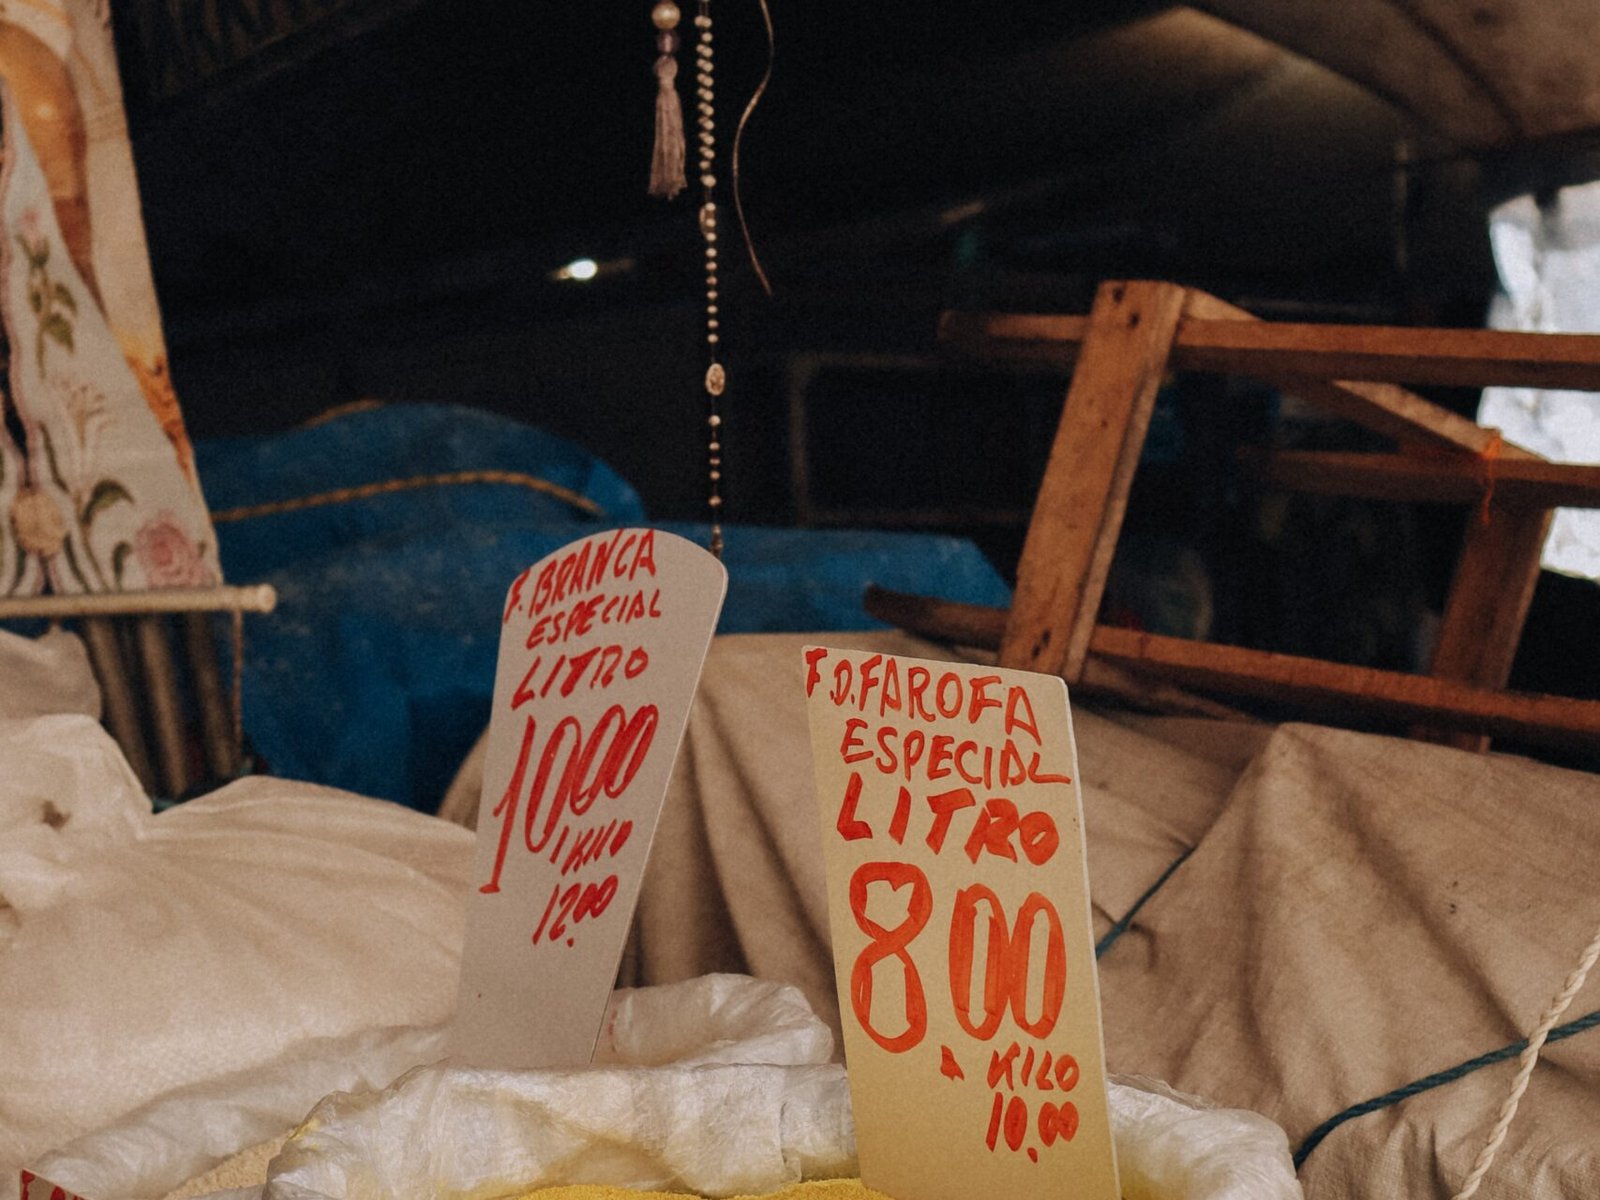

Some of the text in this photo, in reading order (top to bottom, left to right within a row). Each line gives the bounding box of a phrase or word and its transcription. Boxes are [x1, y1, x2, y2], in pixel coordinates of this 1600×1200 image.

[526, 588, 661, 650] ESPECIAL
[511, 644, 649, 711] LITRO
[839, 717, 1072, 790] ESPECIAL
[836, 772, 1060, 866] LITRO
[986, 1041, 1080, 1092] KILO
